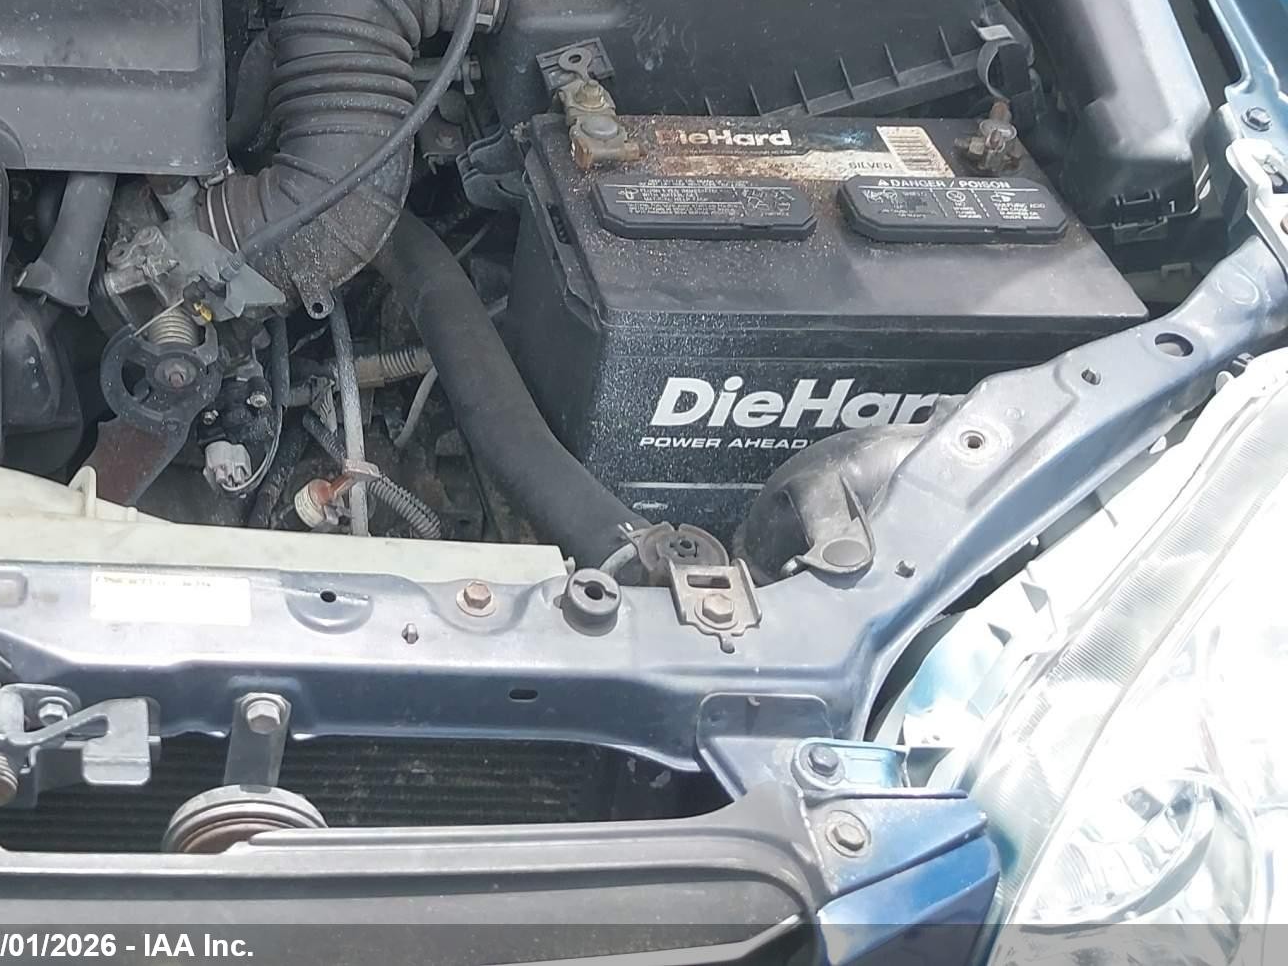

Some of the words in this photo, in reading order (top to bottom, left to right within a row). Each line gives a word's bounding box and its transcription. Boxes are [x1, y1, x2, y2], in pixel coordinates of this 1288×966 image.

[655, 128, 792, 147] DieHard
[848, 161, 893, 171] SILVER
[890, 179, 946, 188] DANGER
[958, 180, 1011, 189] POISON
[650, 376, 962, 428] DieHar
[639, 436, 721, 449] POWER
[727, 437, 809, 449] AHEAD
